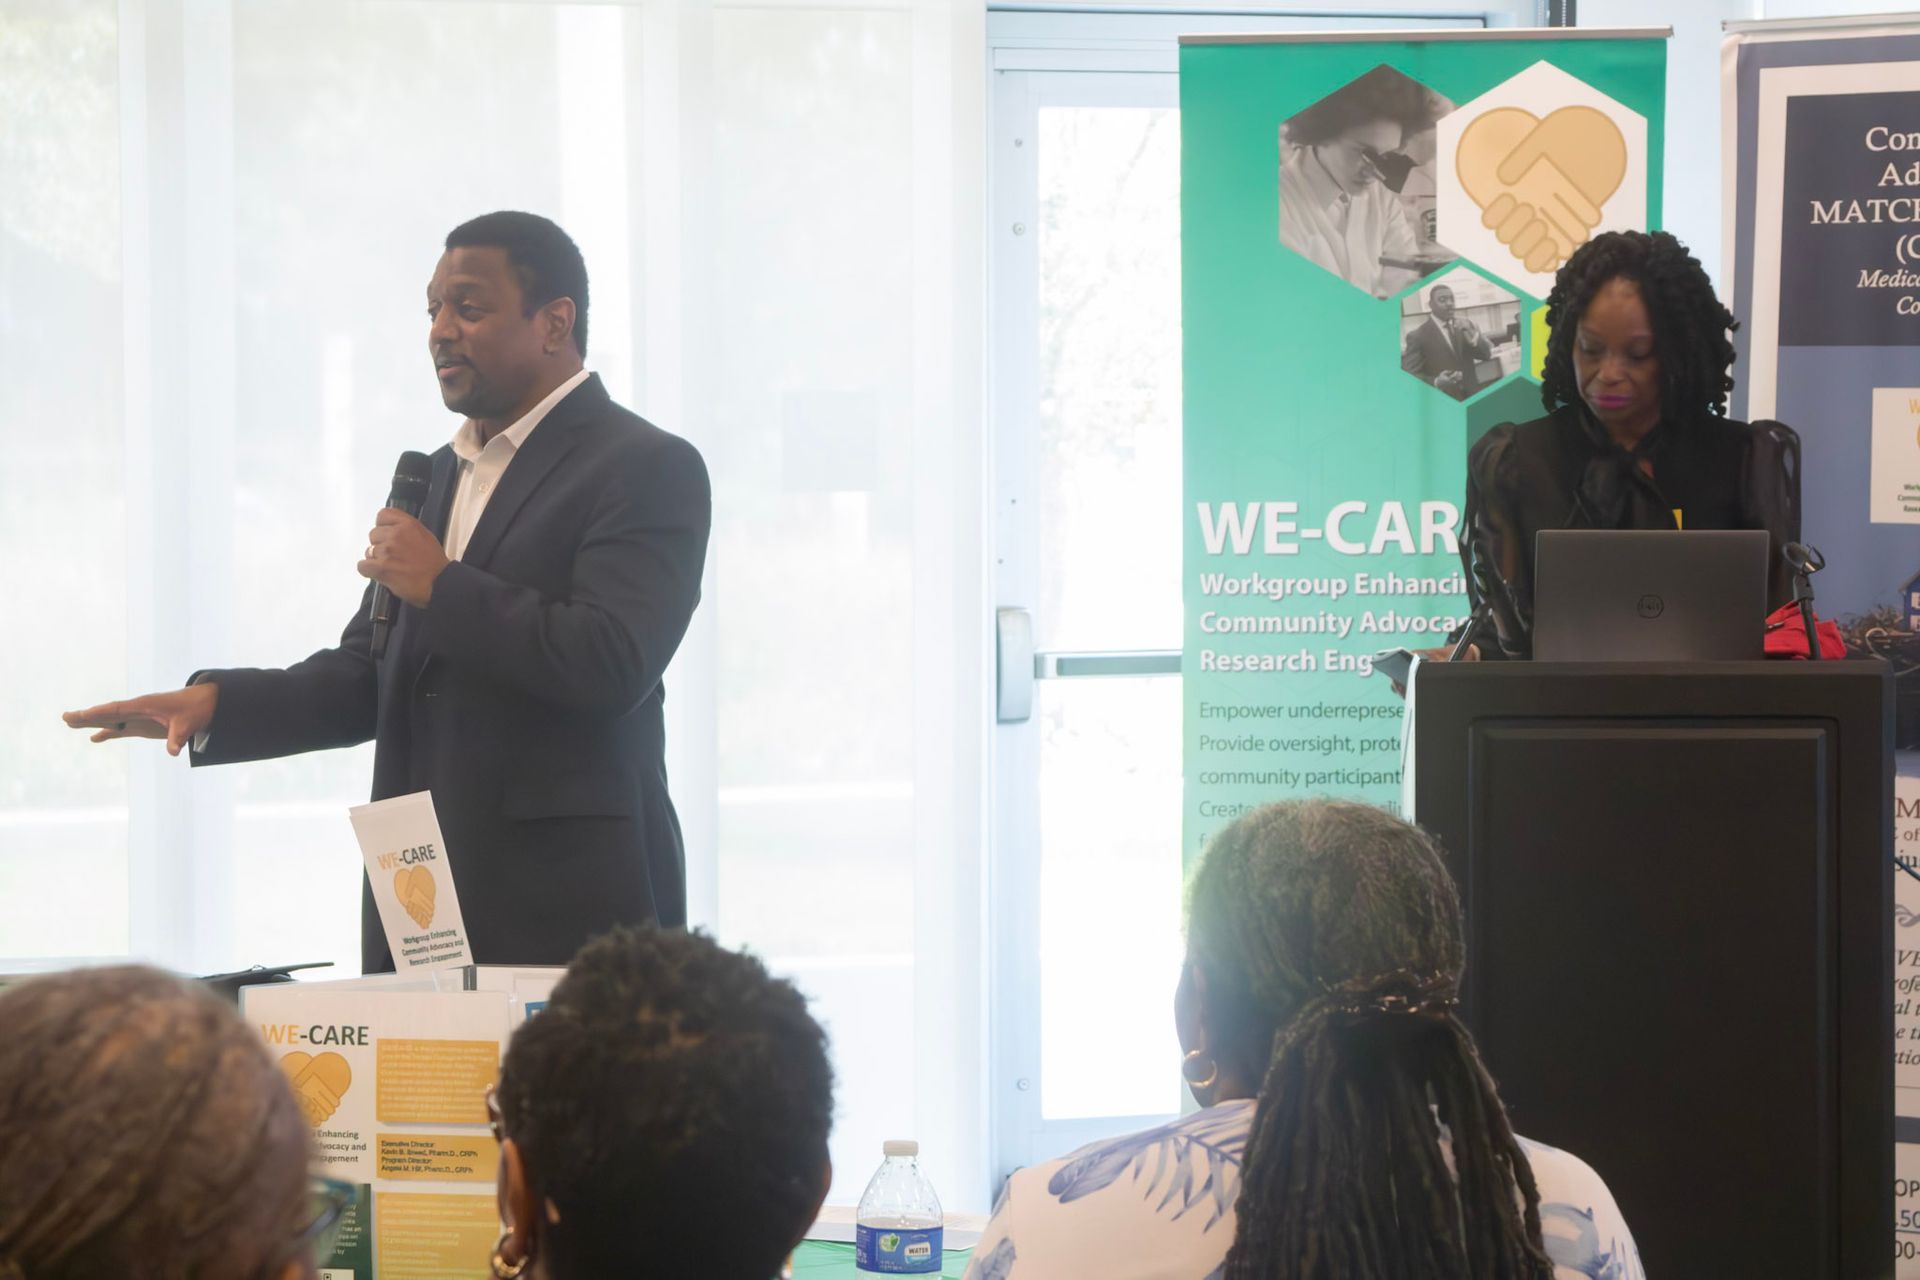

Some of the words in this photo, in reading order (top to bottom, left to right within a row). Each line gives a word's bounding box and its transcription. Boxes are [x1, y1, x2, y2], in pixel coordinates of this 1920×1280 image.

[1197, 501, 1460, 555] WE-CAR
[1200, 573, 1347, 599] Workgroup
[1200, 612, 1352, 637] Community
[1200, 650, 1317, 671] Research
[1200, 702, 1284, 721] Empower
[1200, 735, 1264, 752] Provide
[1269, 735, 1355, 755] oversight,
[1200, 769, 1301, 788] community
[378, 844, 436, 871] WE-CARE
[262, 1024, 369, 1046] WE-CARE
[317, 1130, 359, 1140] Enhancing
[351, 1143, 367, 1151] and
[908, 1247, 928, 1255] WATER
